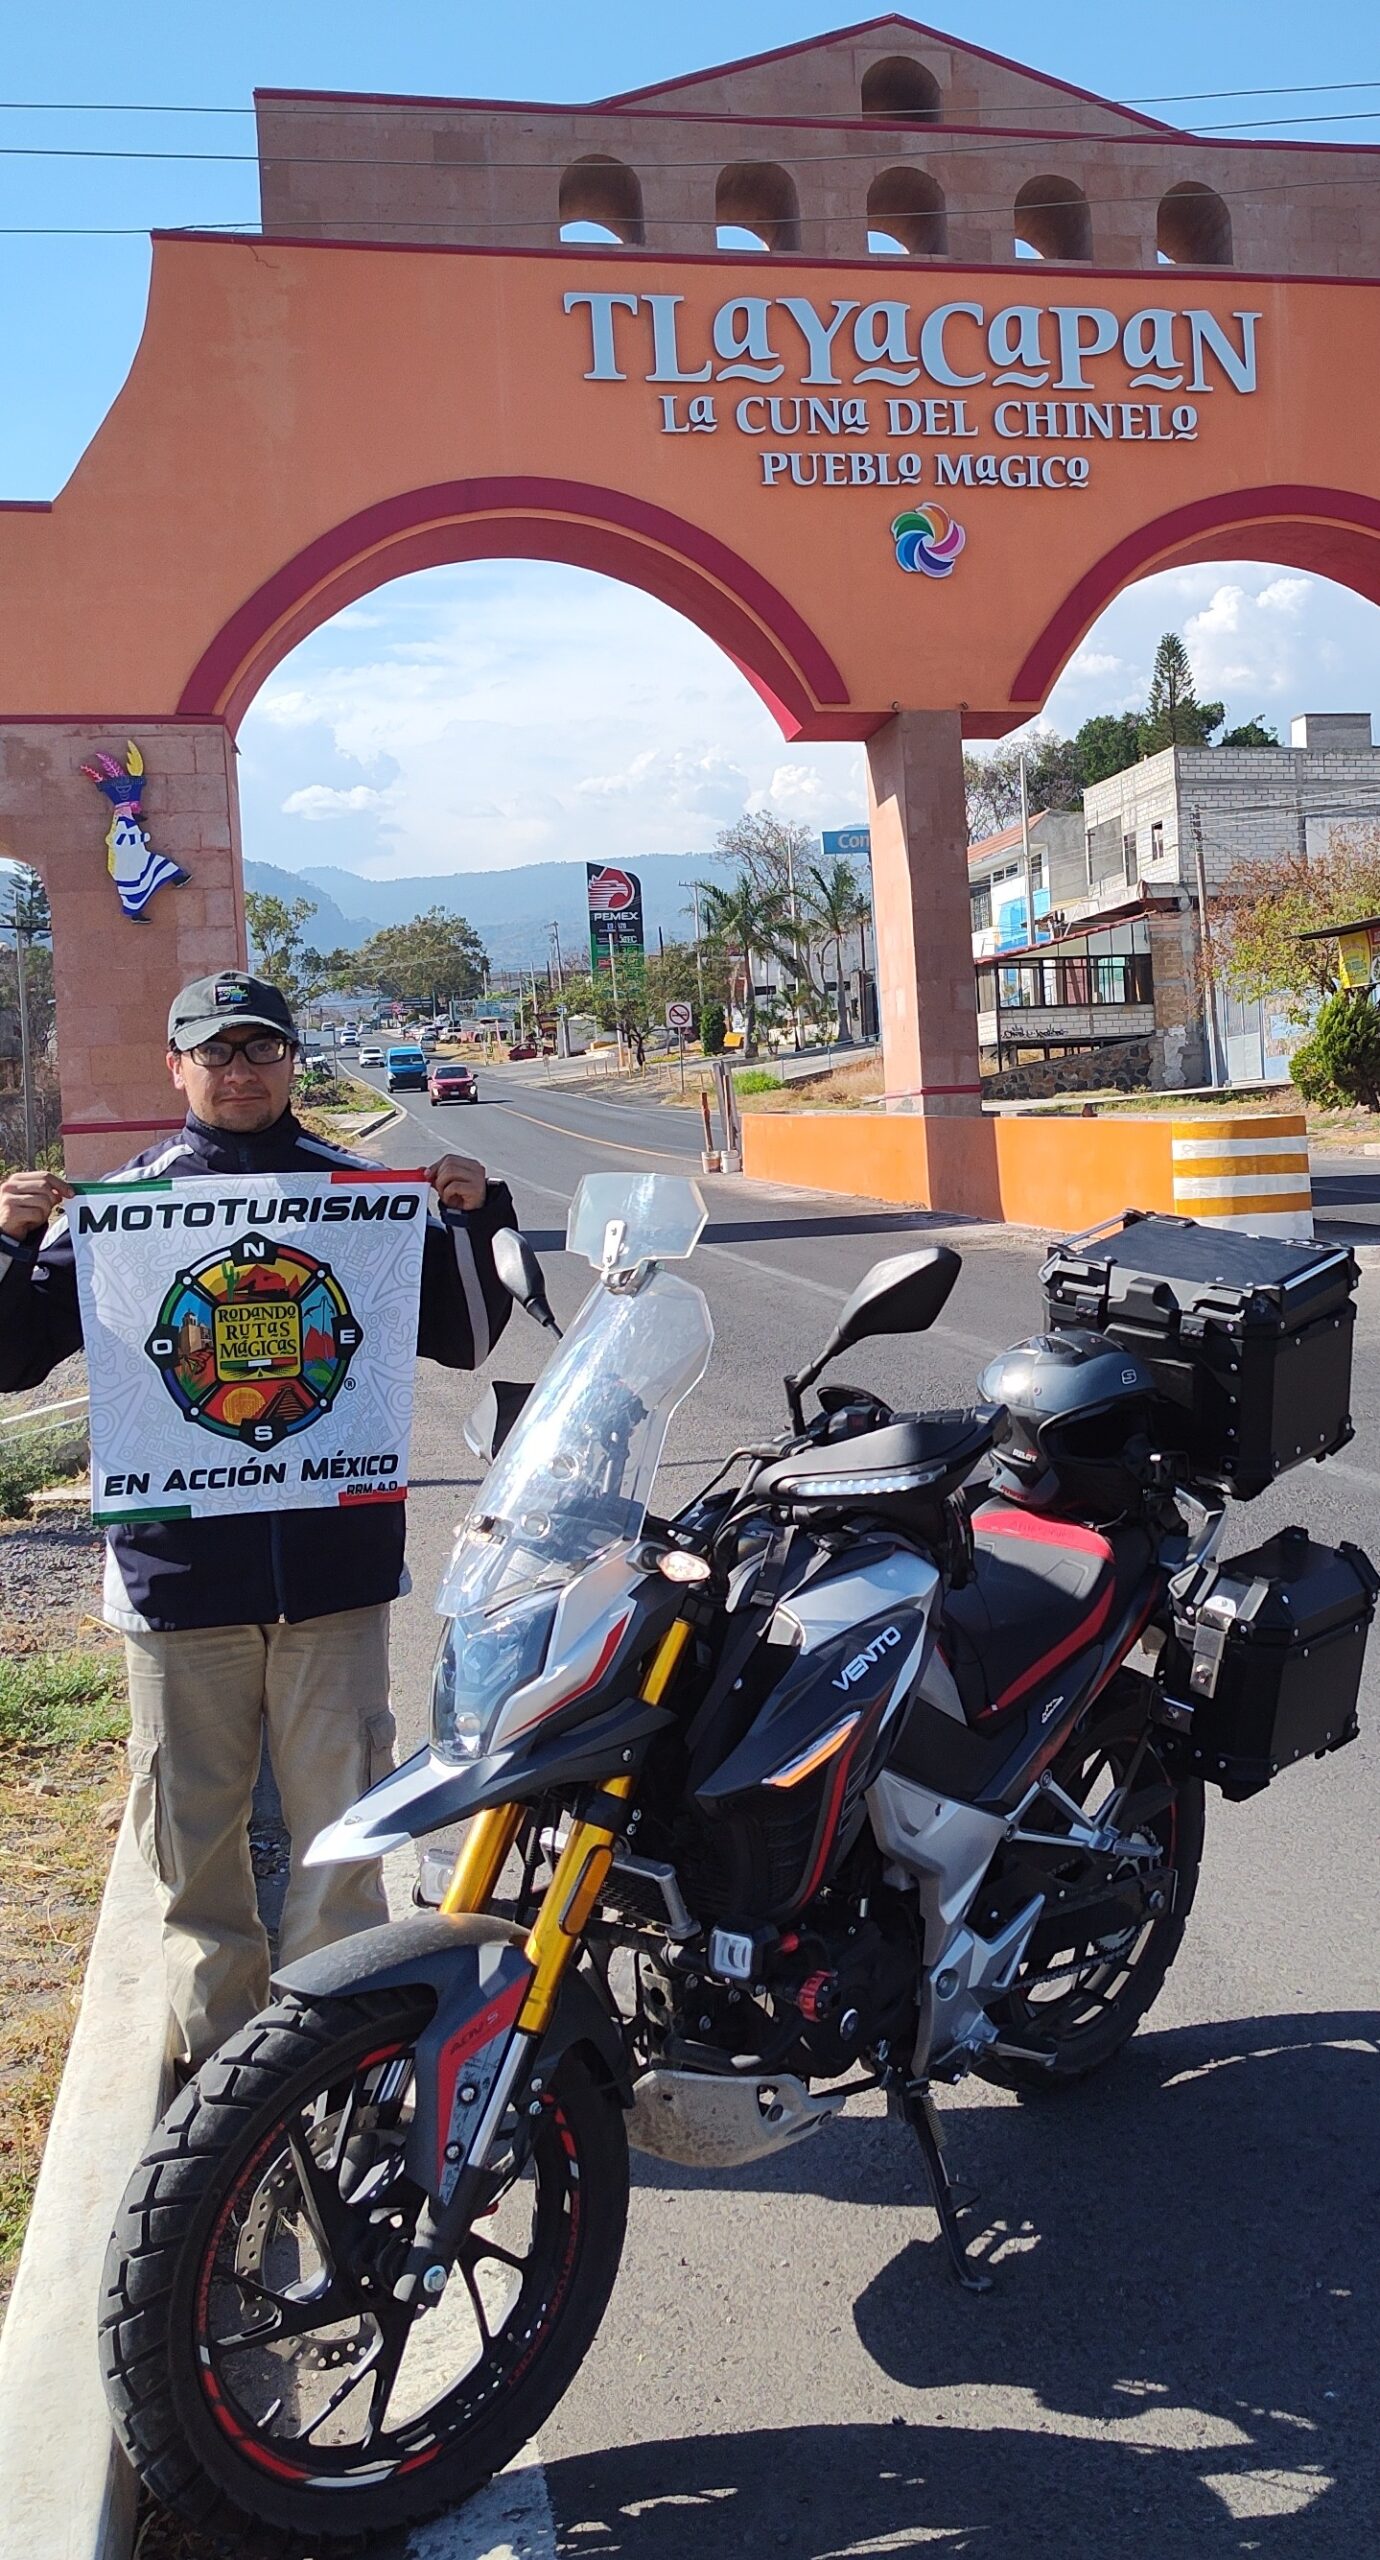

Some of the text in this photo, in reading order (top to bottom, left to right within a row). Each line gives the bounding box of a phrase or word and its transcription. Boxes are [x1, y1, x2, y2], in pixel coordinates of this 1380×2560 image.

[887, 399, 979, 438] DEL
[593, 911, 640, 922] PEMEX
[78, 1194, 421, 1235] MOTOTURISMO
[243, 1242, 265, 1258] N
[340, 1329, 357, 1344] E
[152, 1339, 173, 1355] O
[254, 1426, 273, 1442] S
[104, 1450, 399, 1497] EN ACCIÓN MÉXICO
[377, 1481, 398, 1492] 4.0
[832, 1626, 901, 1691] VENTO
